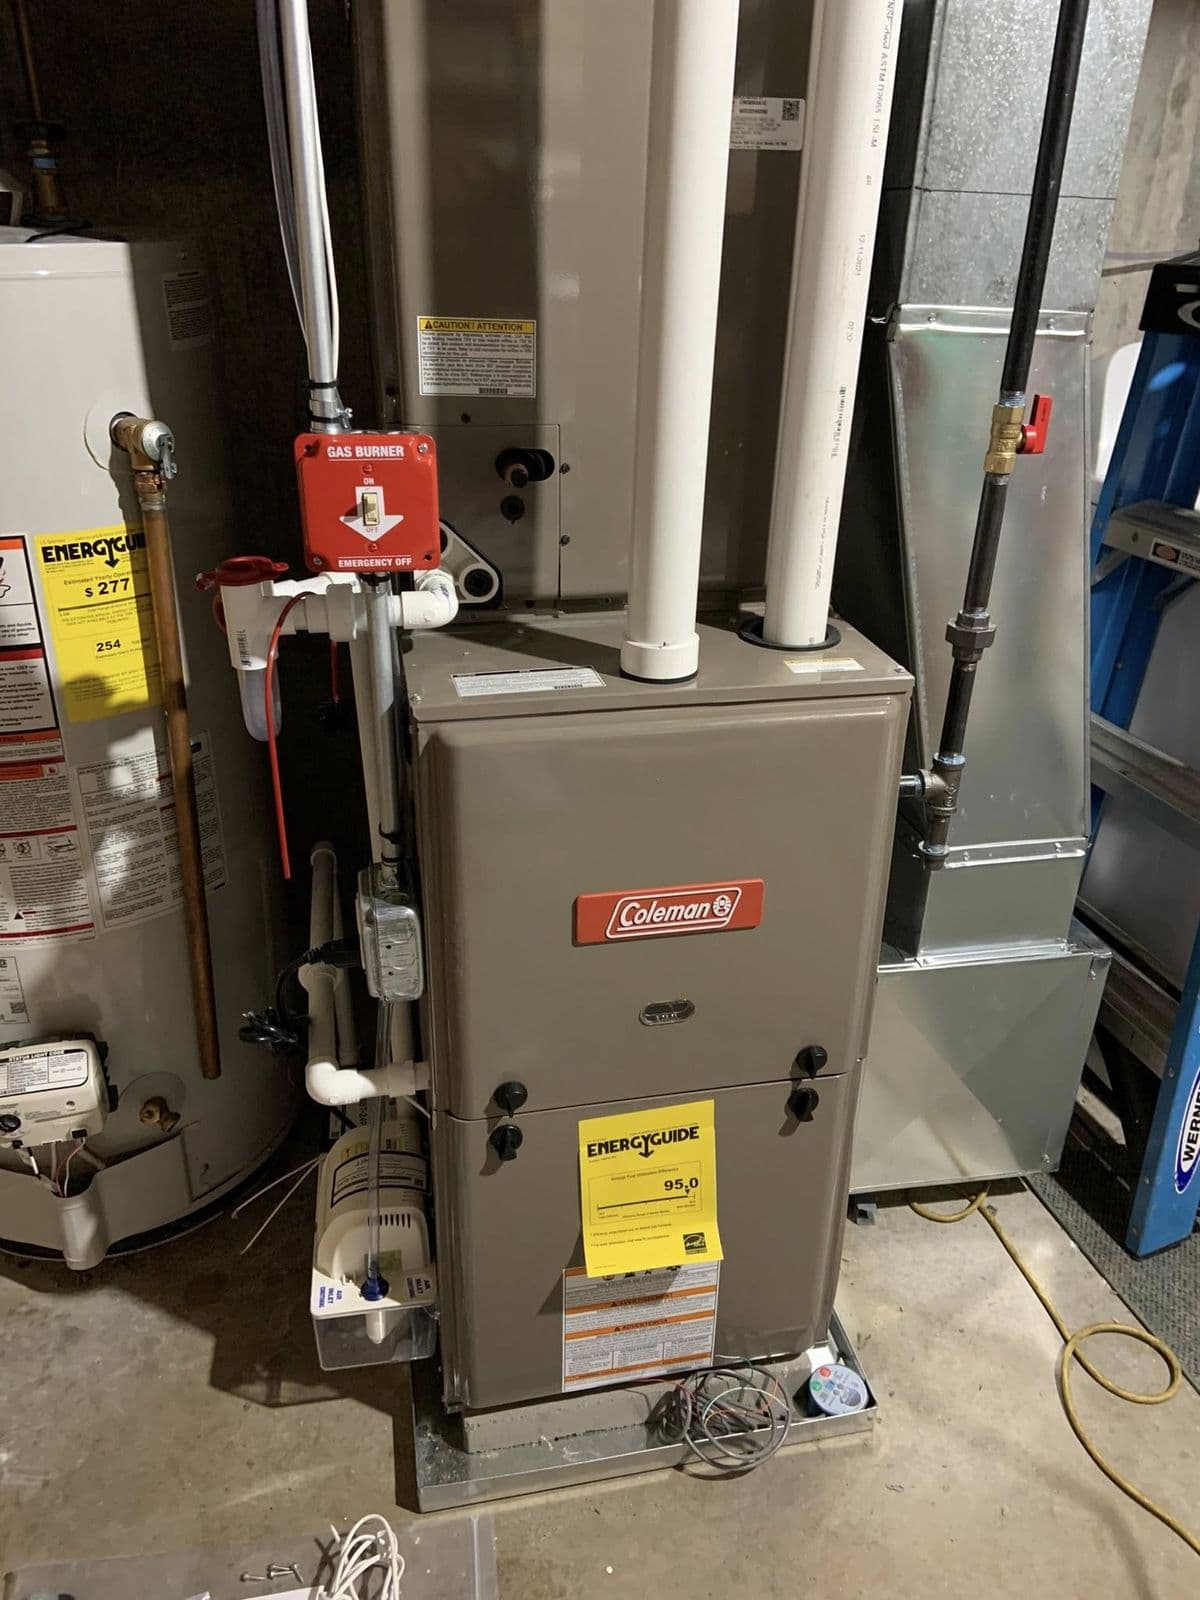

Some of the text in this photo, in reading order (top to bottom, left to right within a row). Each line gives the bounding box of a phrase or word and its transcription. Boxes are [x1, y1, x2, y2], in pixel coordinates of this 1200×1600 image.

[433, 320, 470, 330] CAUTION
[477, 322, 523, 331] ATTENTION
[327, 445, 405, 458] GAS BURNER
[363, 477, 375, 485] ON
[338, 557, 412, 568] EMERGENCY OFF
[97, 577, 130, 596] 277
[96, 639, 121, 652] 254
[620, 900, 711, 927] Coleman
[587, 1126, 699, 1158] ENERGYGUIDE
[664, 1177, 699, 1192] 95.0
